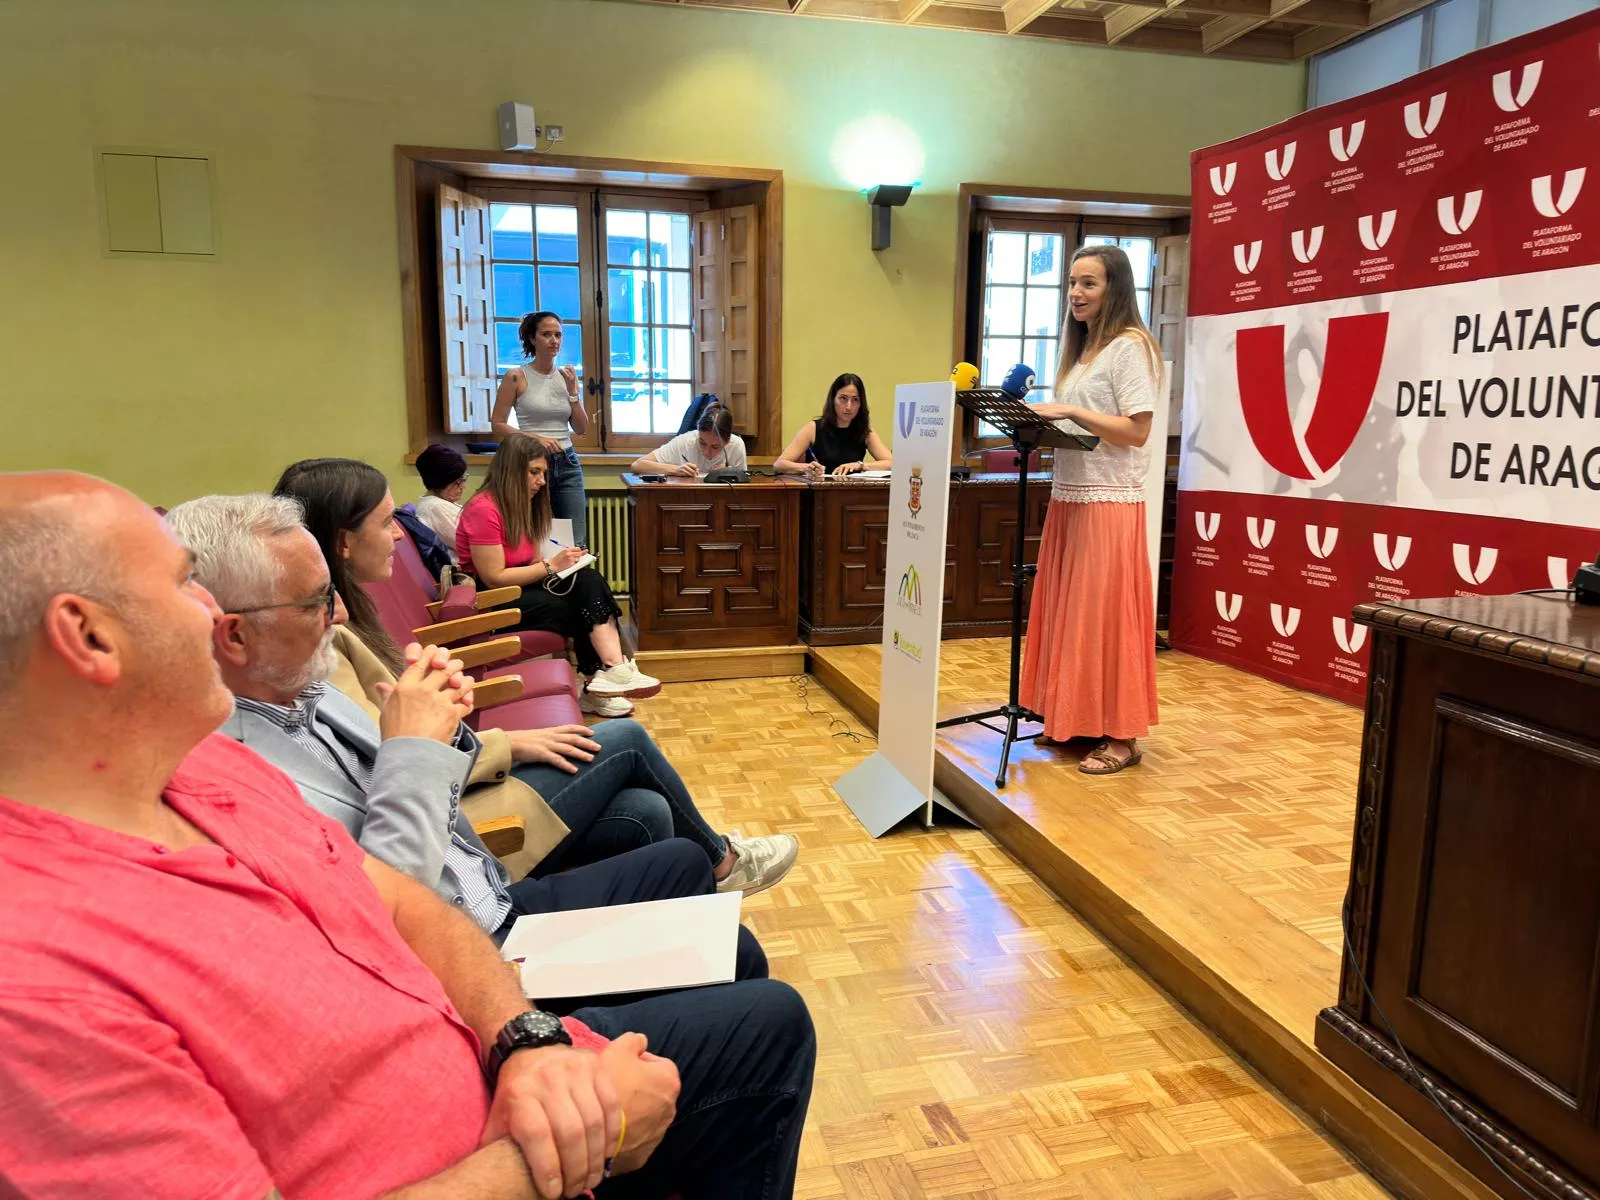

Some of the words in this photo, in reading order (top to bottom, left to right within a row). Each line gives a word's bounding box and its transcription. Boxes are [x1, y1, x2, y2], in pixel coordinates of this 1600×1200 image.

[1453, 301, 1600, 354] PLATAFO
[1396, 380, 1446, 417] DEL
[1450, 442, 1492, 482] DE
[1500, 443, 1600, 491] ARAG
